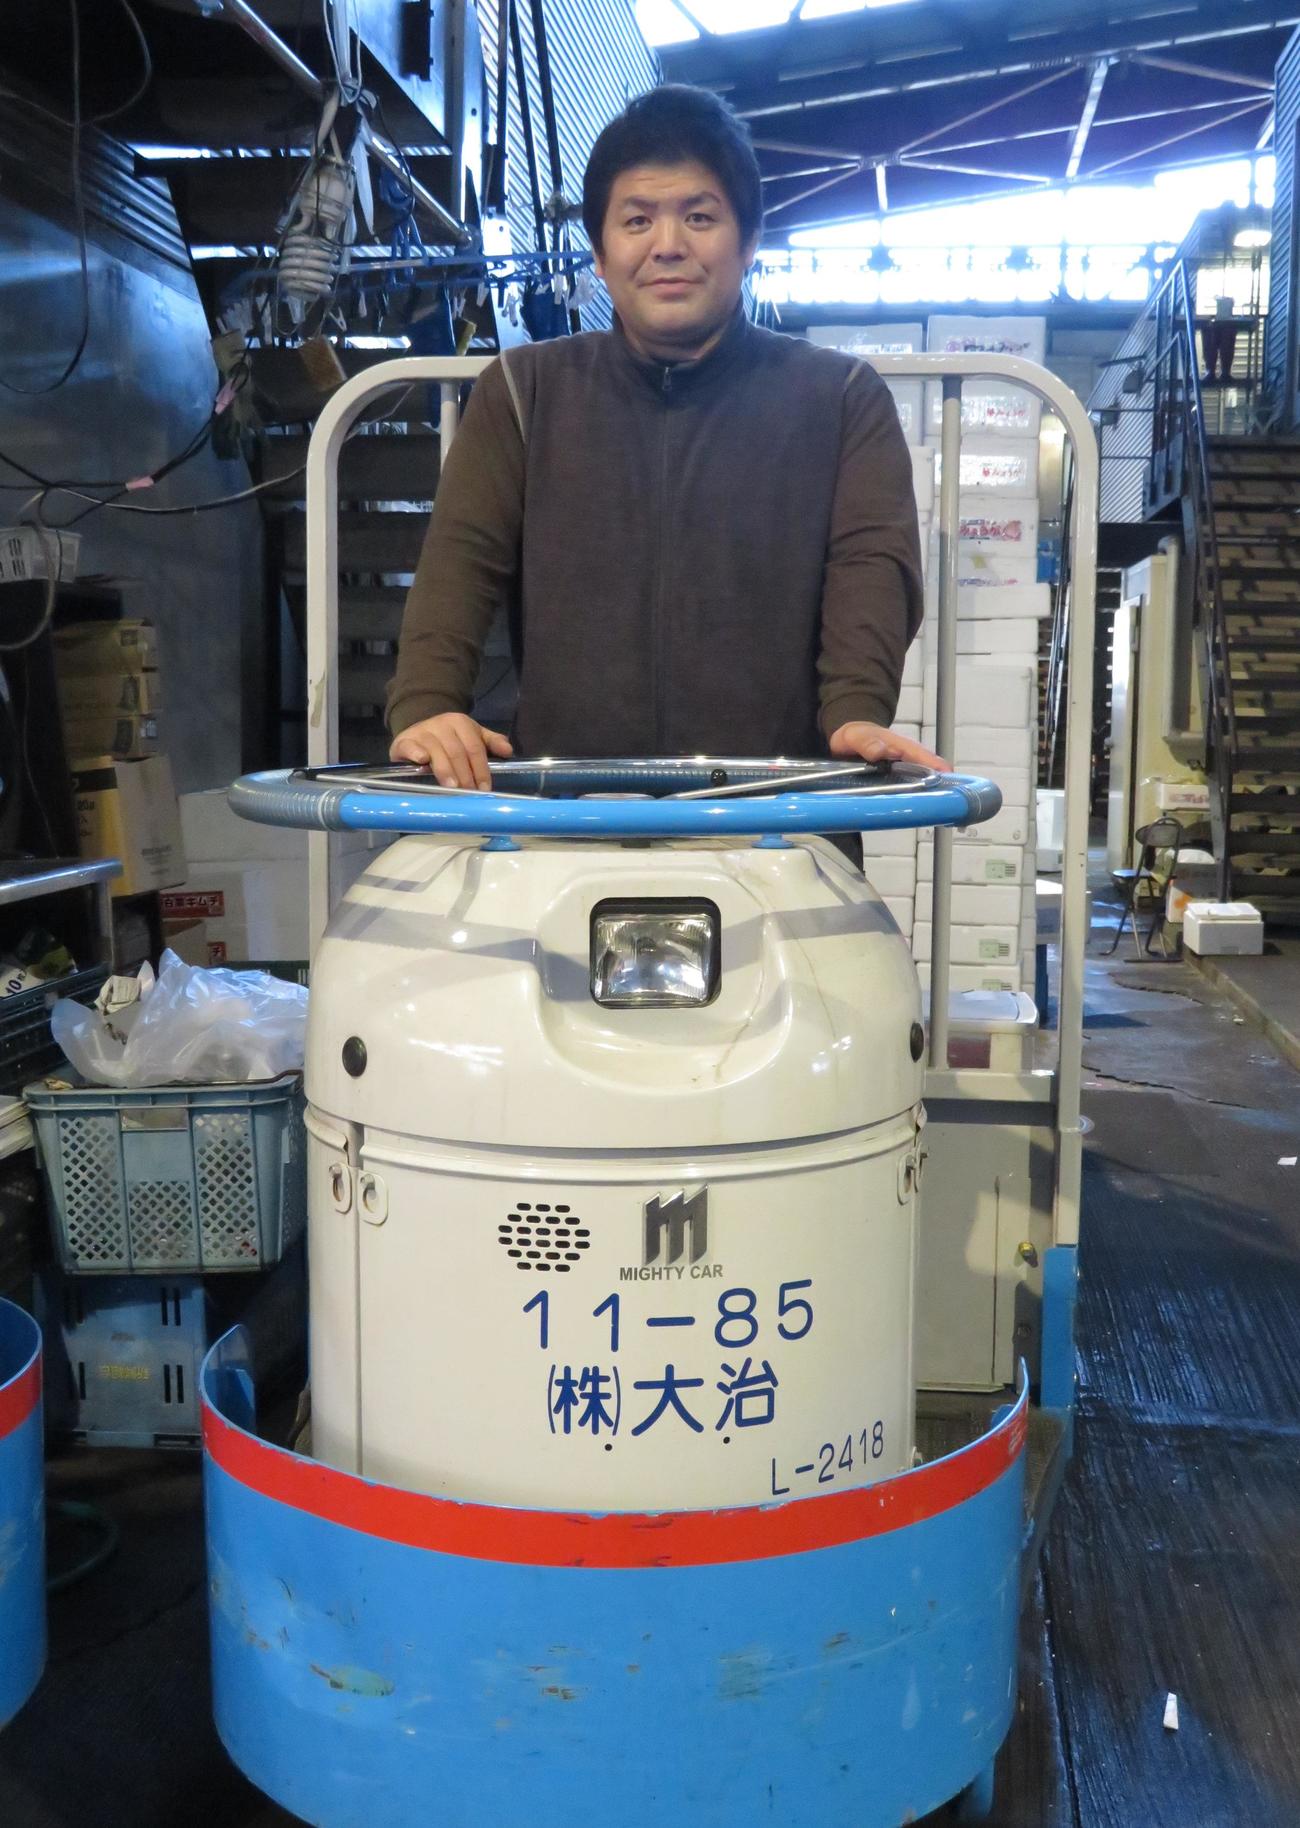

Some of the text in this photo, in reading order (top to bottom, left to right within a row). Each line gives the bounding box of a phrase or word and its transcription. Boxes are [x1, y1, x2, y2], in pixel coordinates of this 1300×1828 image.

[619, 1264, 724, 1281] MIGHTY CAR
[548, 1357, 779, 1437] (株)大治
[771, 1420, 884, 1496] L-2418
